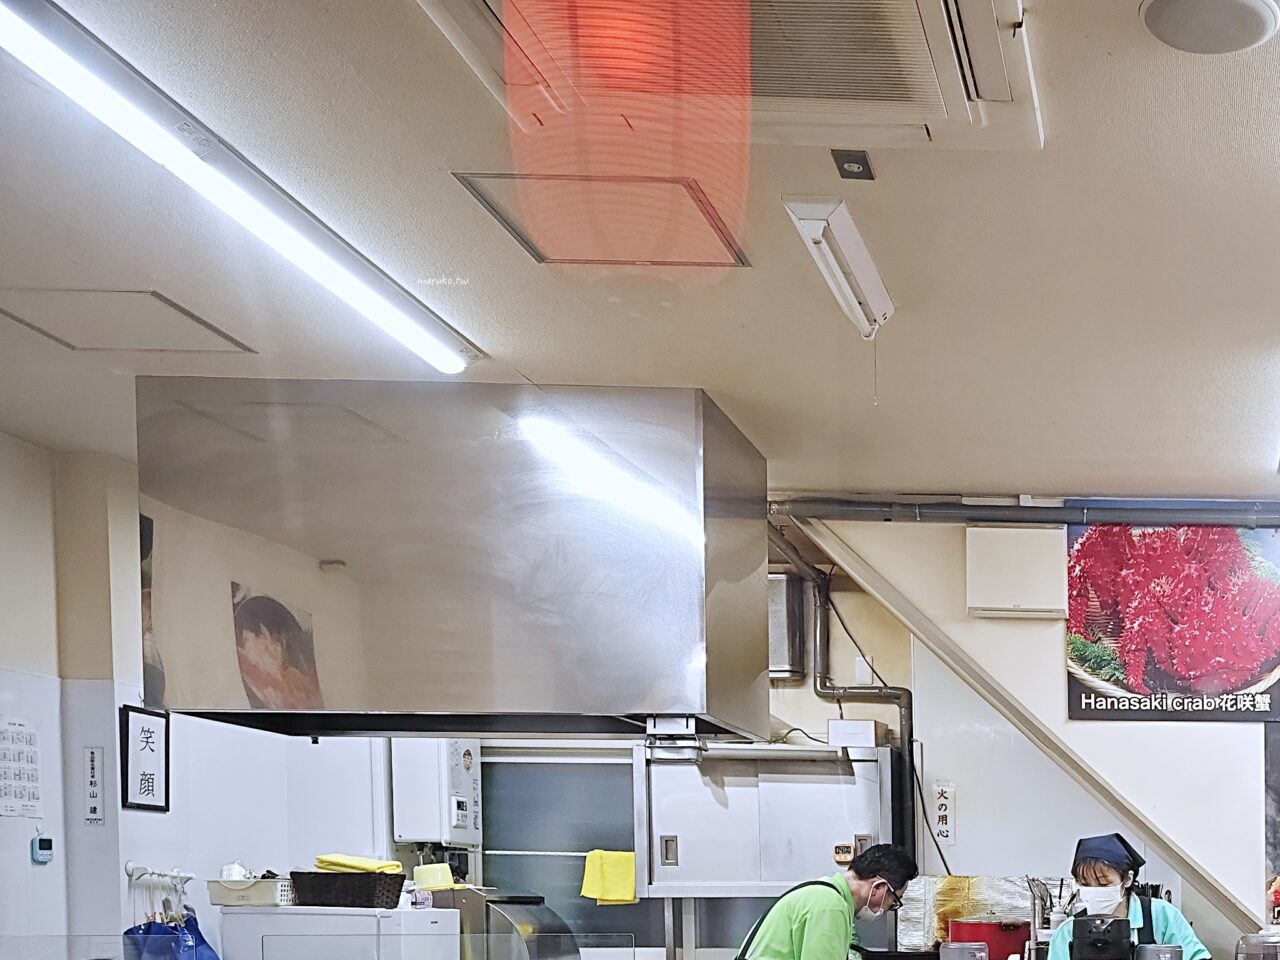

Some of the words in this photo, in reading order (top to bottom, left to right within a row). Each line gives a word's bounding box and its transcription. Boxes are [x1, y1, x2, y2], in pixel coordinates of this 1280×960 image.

[1081, 693, 1167, 711] Hanasaki
[1172, 694, 1216, 711] crab
[1219, 693, 1272, 712] 花咲蟹
[139, 726, 156, 798] 笑顔
[937, 788, 950, 838] 火の用心
